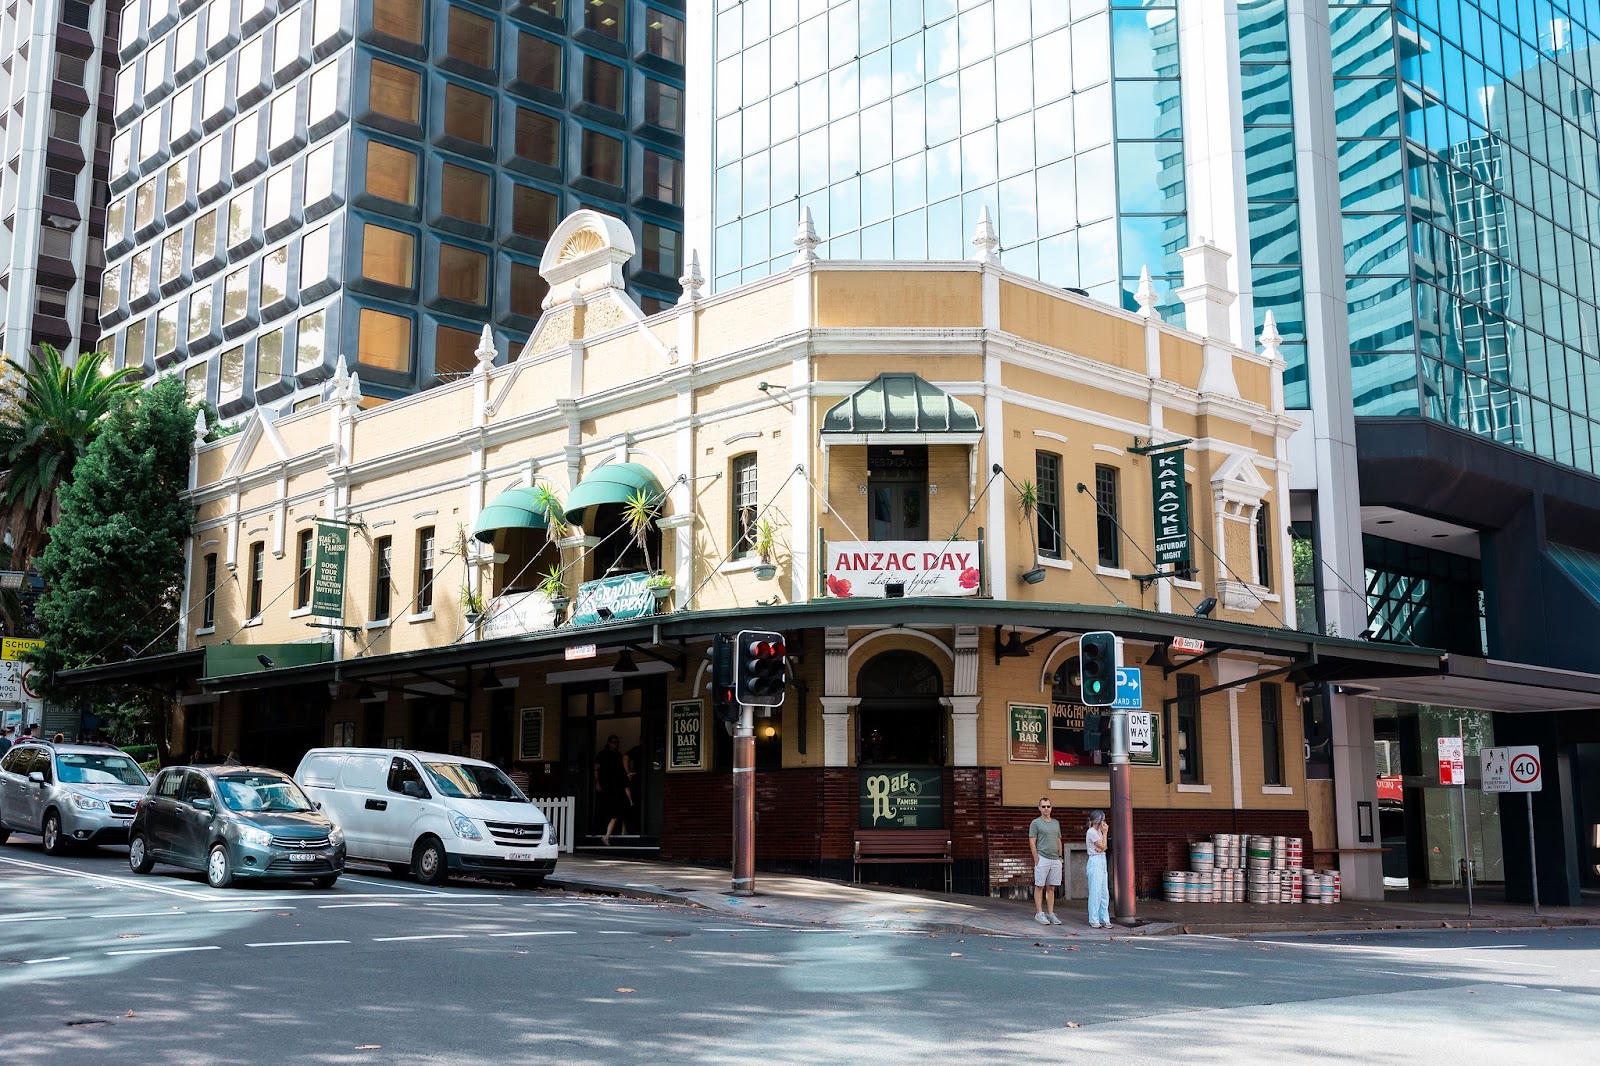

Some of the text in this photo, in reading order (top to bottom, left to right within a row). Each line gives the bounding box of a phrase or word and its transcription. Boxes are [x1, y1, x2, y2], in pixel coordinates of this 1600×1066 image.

[1157, 456, 1180, 536] KARAOKE
[324, 543, 345, 554] FAMISH
[1155, 540, 1187, 552] SATURDAY
[1162, 551, 1182, 560] NIGHT
[321, 562, 338, 570] BOOK
[835, 552, 971, 571] ANZAC DAY
[321, 568, 338, 576] YOUR
[321, 574, 336, 582] NEXT
[867, 572, 893, 585] Lest
[907, 573, 943, 592] forget
[316, 580, 341, 589] FUNCTION
[316, 586, 332, 594] WITH
[1132, 698, 1139, 706] ST
[1052, 703, 1067, 718] RAG
[1131, 715, 1148, 725] ONE
[674, 718, 699, 734] 1860
[1015, 720, 1042, 733] 1860
[1018, 732, 1040, 744] BAR
[1130, 727, 1149, 738] WAY
[676, 734, 697, 747] BAR
[1515, 762, 1535, 775] 40
[909, 782, 917, 794] &
[896, 797, 918, 805] FAMISH
